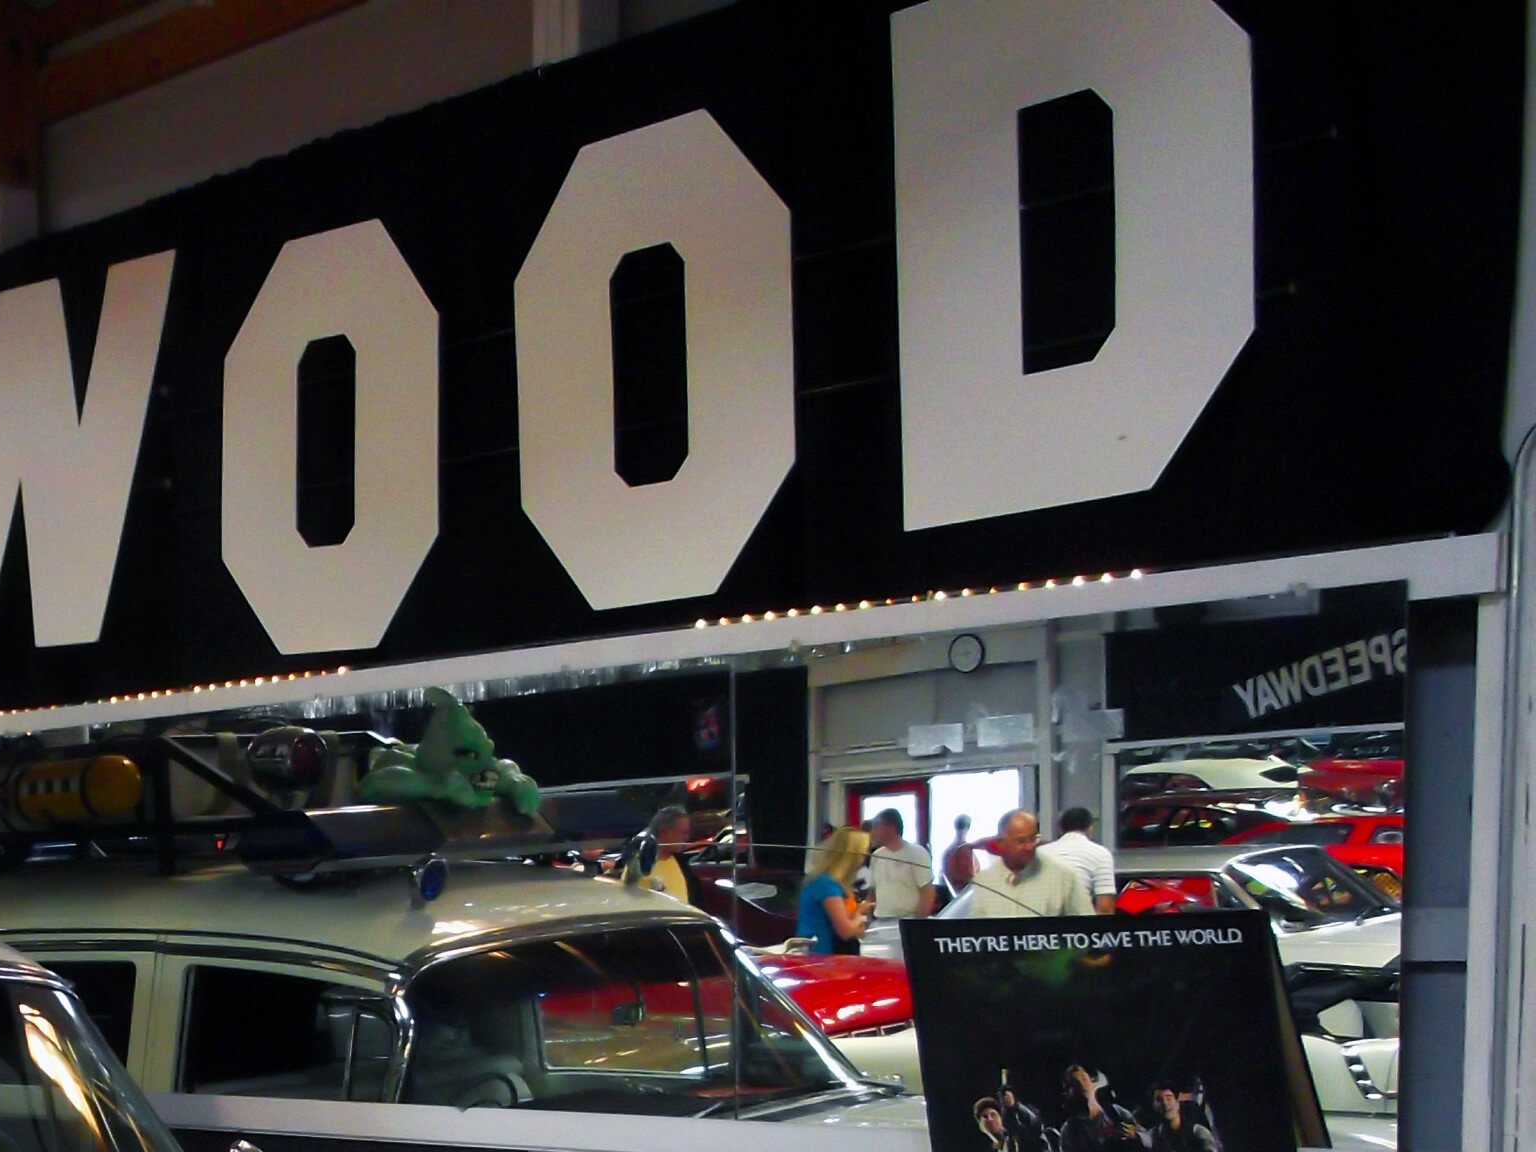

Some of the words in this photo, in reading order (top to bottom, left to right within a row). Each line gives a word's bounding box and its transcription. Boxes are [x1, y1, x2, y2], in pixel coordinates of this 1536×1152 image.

[935, 935, 1010, 954] THEY'RE
[1014, 933, 1060, 951] HERE
[1063, 932, 1088, 949] TO
[1091, 931, 1133, 948] SAVE
[1135, 930, 1171, 947] THE
